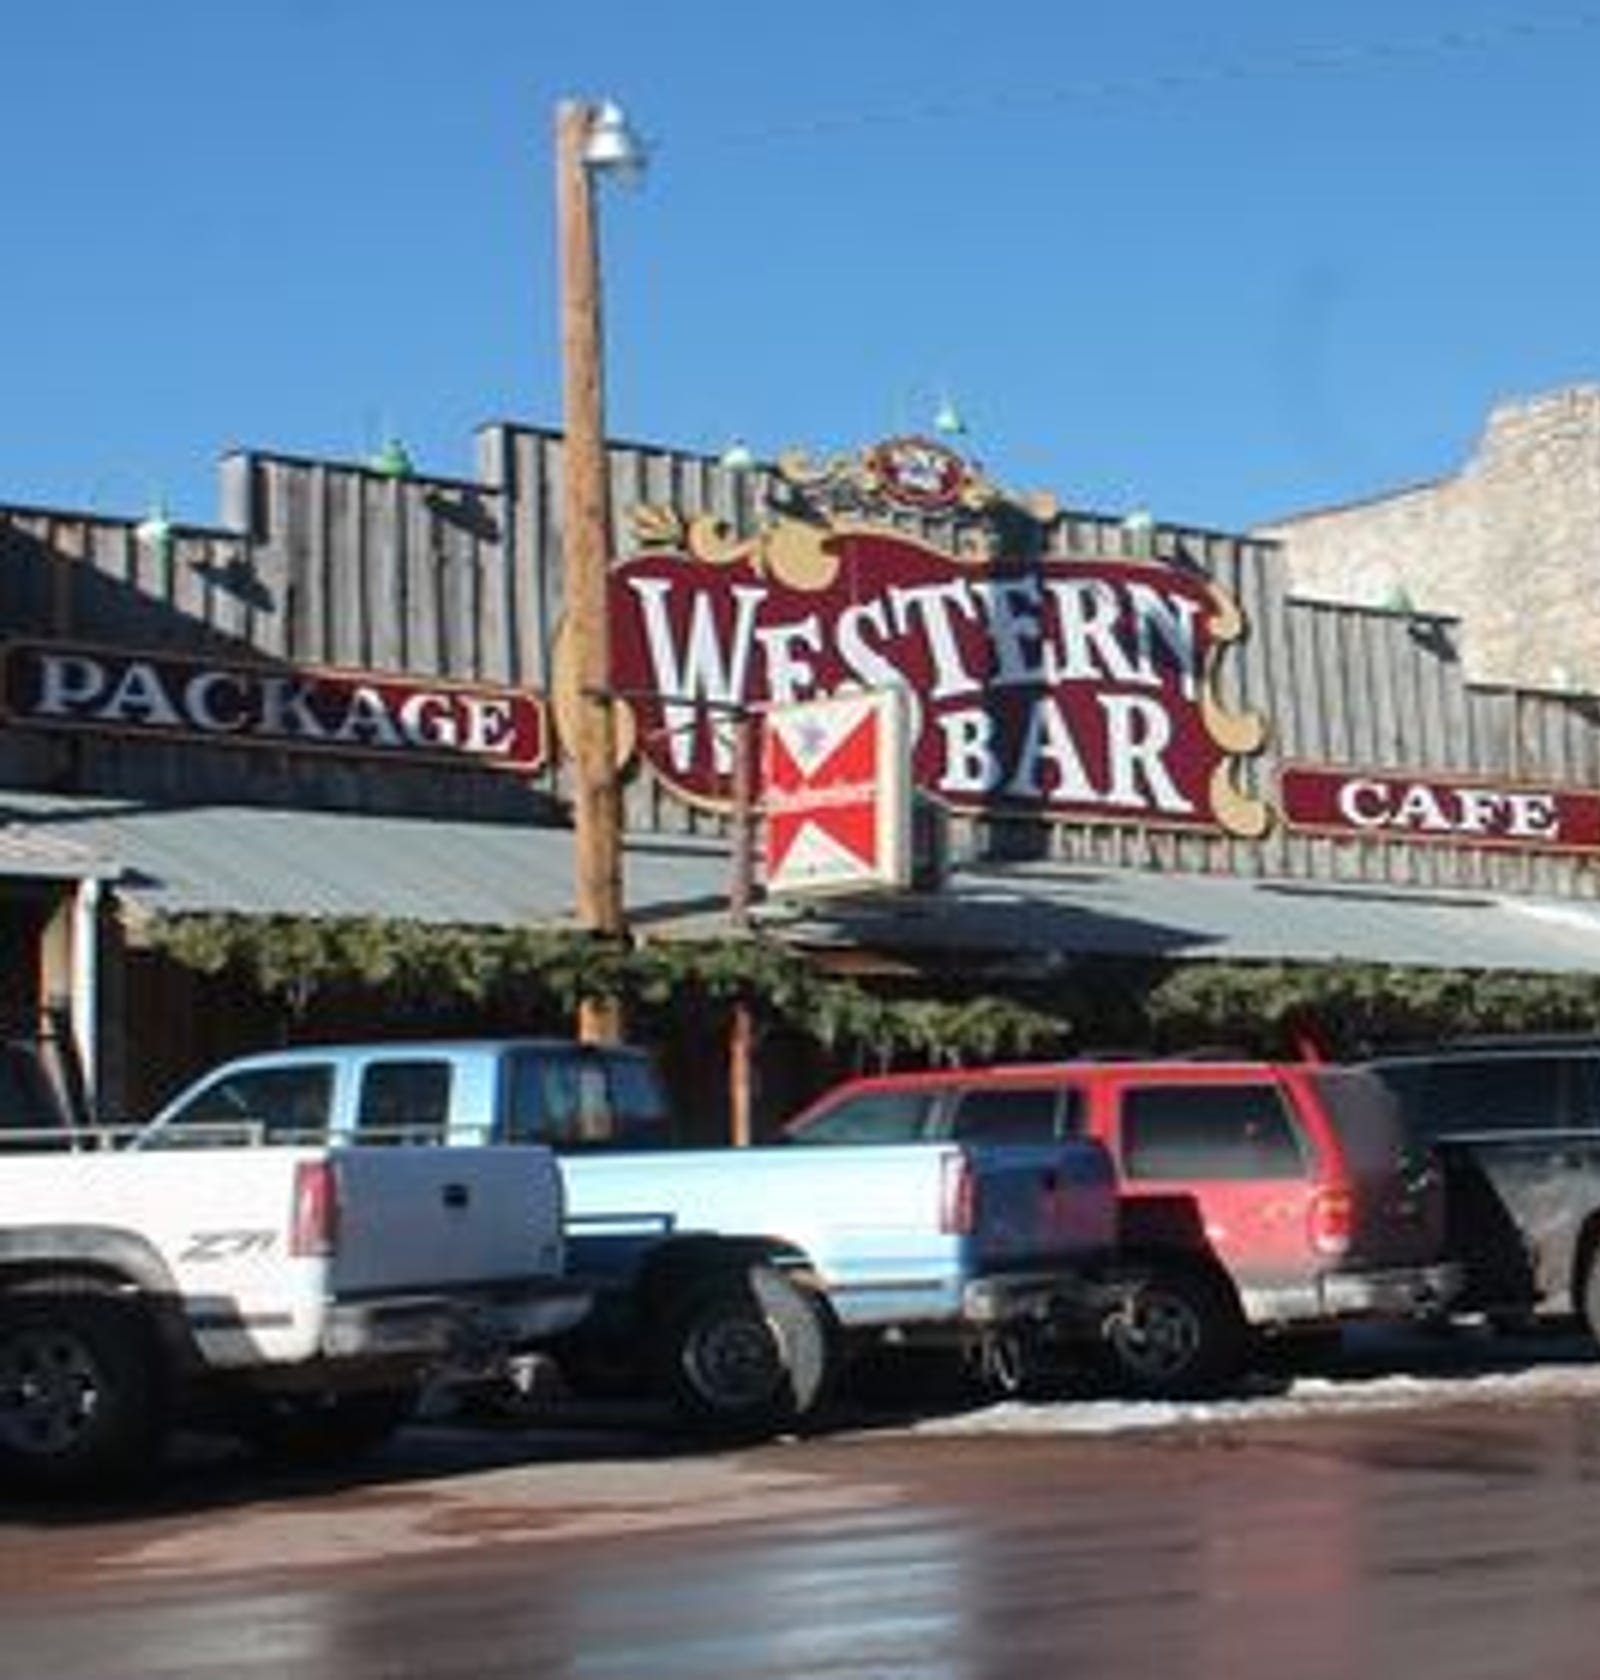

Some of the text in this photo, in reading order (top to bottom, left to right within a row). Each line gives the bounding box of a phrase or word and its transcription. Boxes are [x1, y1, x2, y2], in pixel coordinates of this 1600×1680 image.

[32, 654, 518, 754] PACKAGE
[629, 573, 1198, 775] WESTERN
[939, 694, 1193, 813] BAR
[1337, 779, 1560, 840] CAFE
